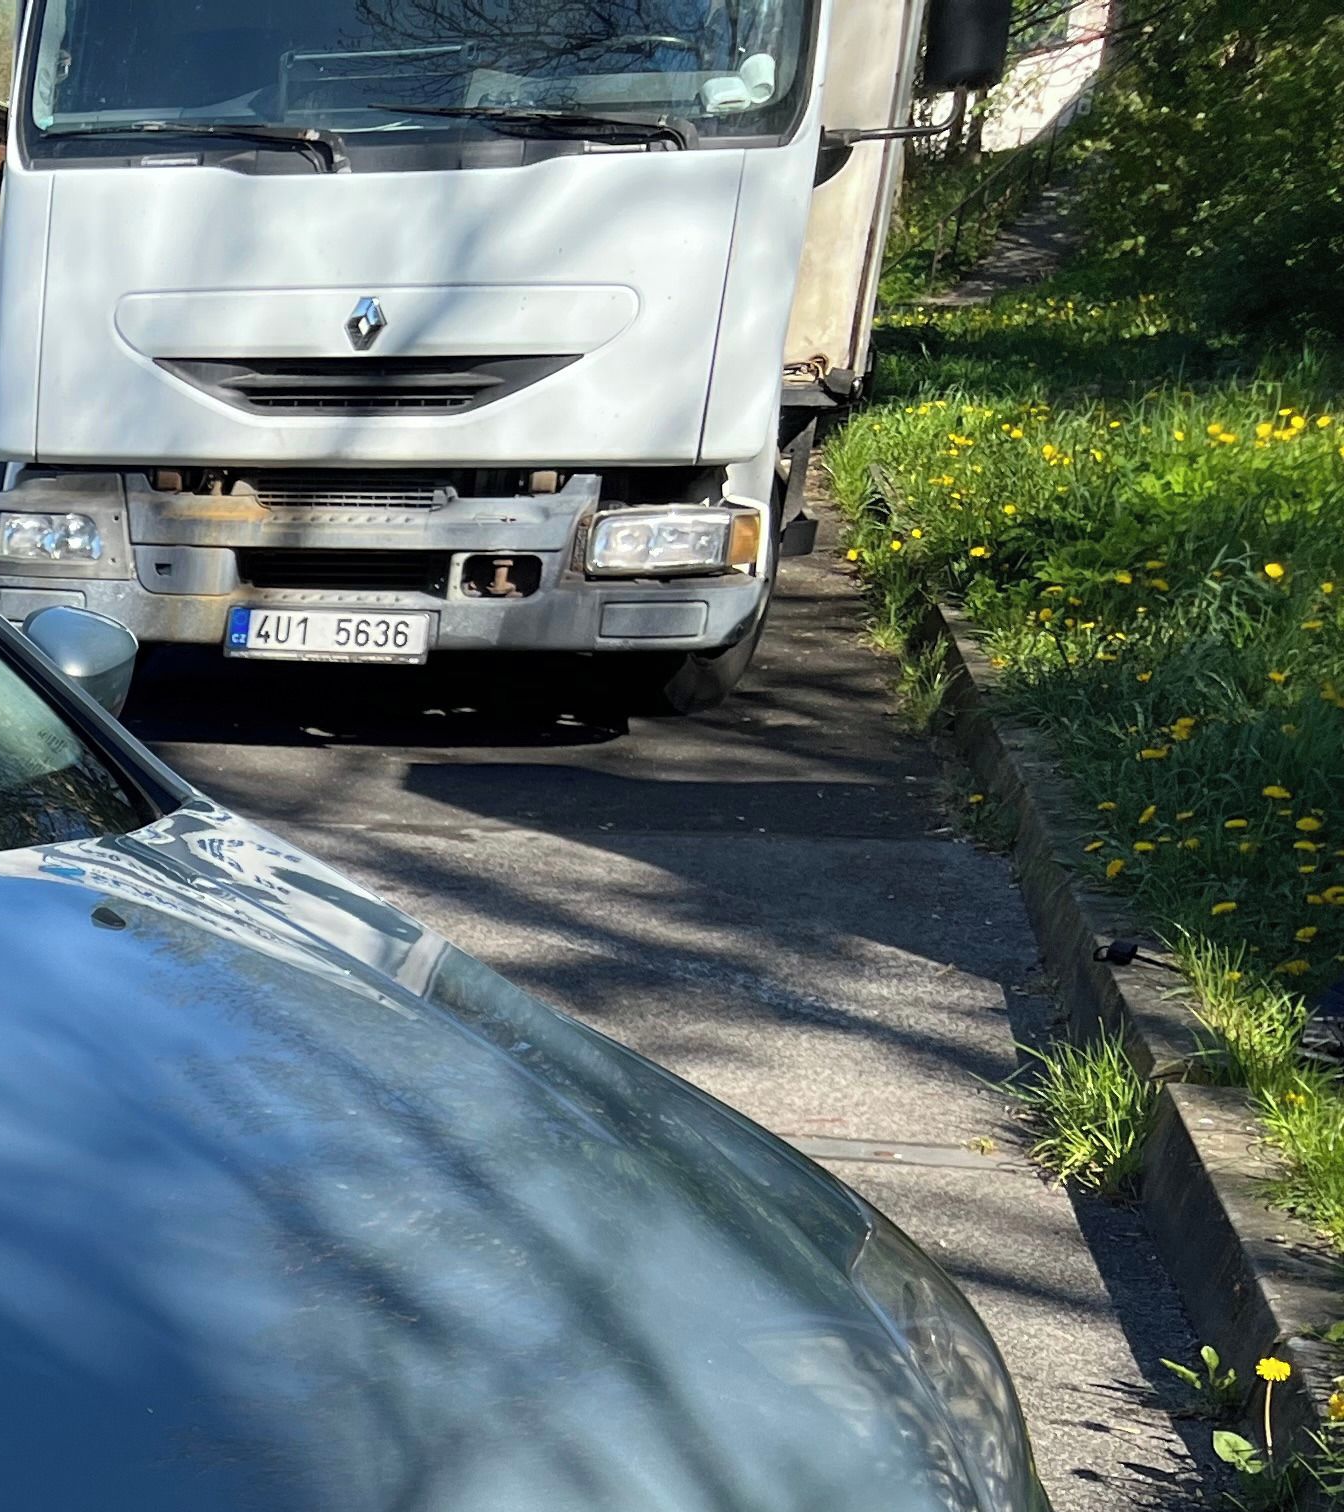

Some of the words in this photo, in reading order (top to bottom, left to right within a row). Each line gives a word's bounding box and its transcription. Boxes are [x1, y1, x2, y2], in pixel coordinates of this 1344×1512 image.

[231, 633, 246, 644] CZ
[256, 615, 309, 646] 4U1
[335, 618, 410, 648] 5636
